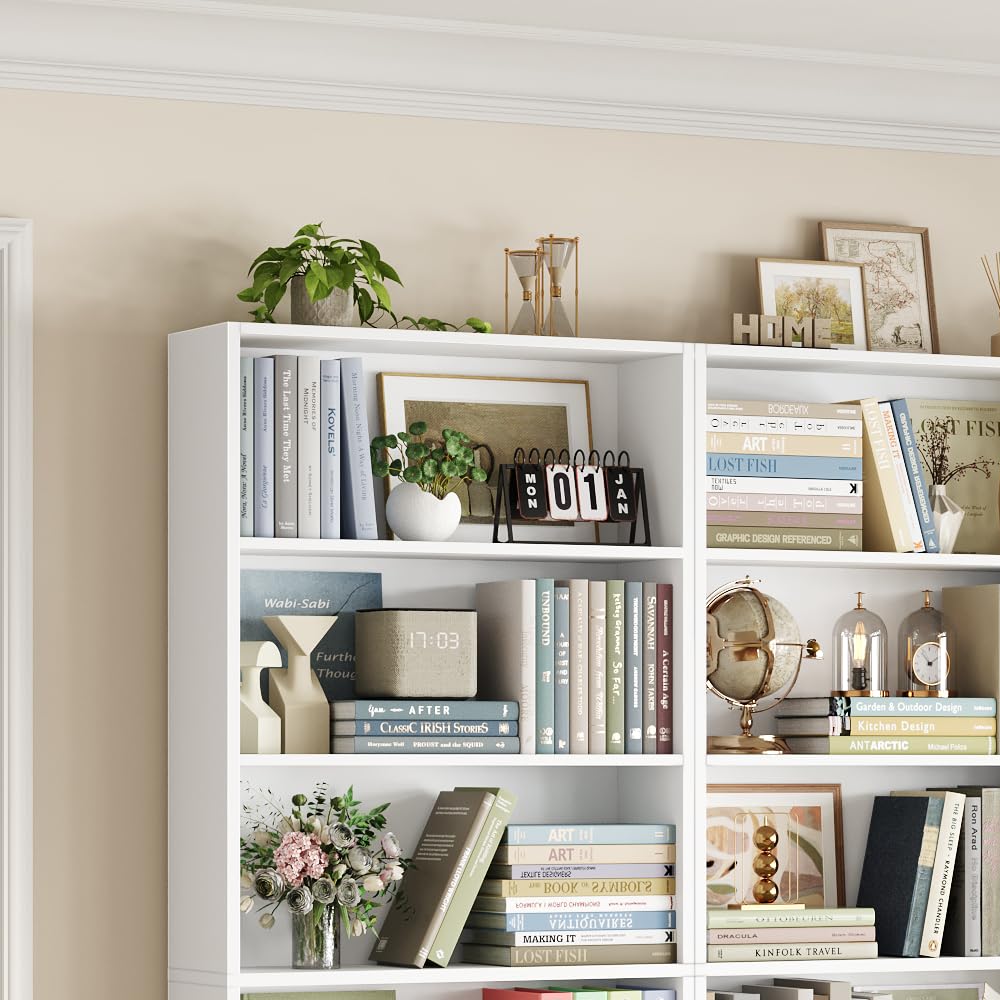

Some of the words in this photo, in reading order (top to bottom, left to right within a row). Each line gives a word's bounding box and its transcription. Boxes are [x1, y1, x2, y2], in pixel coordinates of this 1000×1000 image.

[733, 312, 832, 348] HOME
[282, 370, 292, 388] The
[282, 390, 292, 410] Last
[282, 414, 292, 436] Time
[280, 440, 292, 462] They
[742, 436, 768, 451] ART
[282, 465, 292, 482] Met
[708, 456, 744, 472] LOST
[747, 458, 778, 474] FISH
[524, 474, 538, 508] MON
[553, 472, 598, 510] 01
[614, 474, 628, 514] JAN
[716, 532, 750, 543] GRAPHIC
[752, 534, 780, 544] DESIGN
[782, 534, 832, 545] REFERENCED
[264, 598, 330, 609] Wabi-Sabi
[542, 592, 550, 646] UNBOUND
[647, 596, 656, 650] SAVANNAH
[409, 632, 460, 649] 17:03
[409, 706, 450, 715] AFTER
[856, 702, 886, 712] Garden
[888, 703, 895, 712] &
[898, 702, 932, 712] Outdoor
[936, 702, 962, 714] Design
[858, 720, 896, 731] Kitchen
[901, 720, 935, 733] Design
[850, 740, 910, 750] ANTARCTIC
[548, 830, 576, 841] ART
[458, 848, 470, 867] FRANK
[548, 848, 574, 861] ART
[450, 867, 462, 887] LLOYD
[939, 860, 950, 896] RAYMOND
[440, 887, 454, 912] WRIGHT
[933, 898, 944, 934] CHANDLER
[523, 935, 563, 944] MAKING
[566, 935, 576, 943] IT
[515, 950, 552, 963] LOST
[556, 950, 588, 962] FISH
[806, 948, 842, 956] TRAVEL
